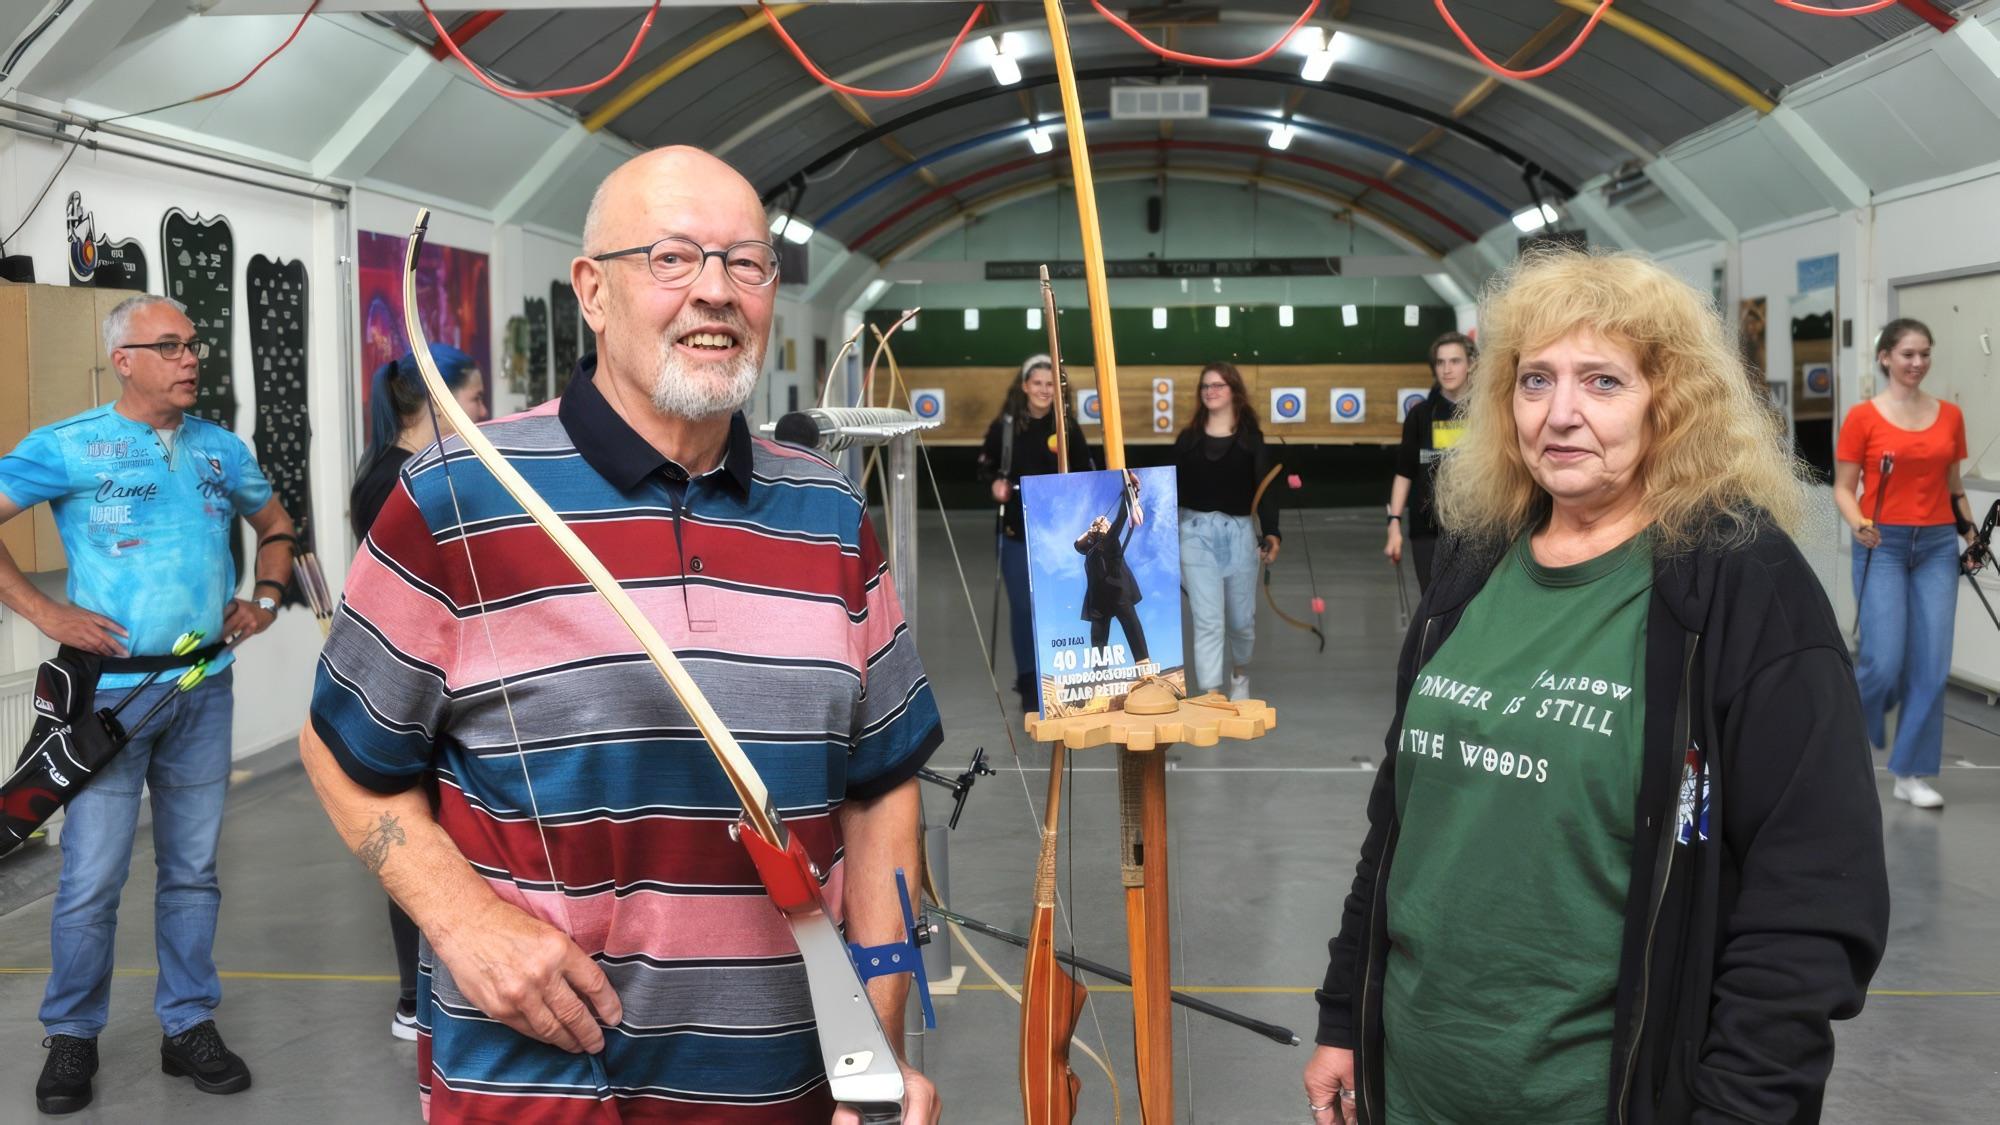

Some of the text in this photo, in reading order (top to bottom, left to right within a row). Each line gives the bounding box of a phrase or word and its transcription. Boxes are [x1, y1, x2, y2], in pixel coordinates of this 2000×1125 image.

[1053, 644, 1126, 671] 40 JAAR
[1502, 696, 1526, 715] IS
[1535, 698, 1614, 737] STILL
[1410, 729, 1445, 760] THE
[1459, 740, 1549, 783] WOODS
